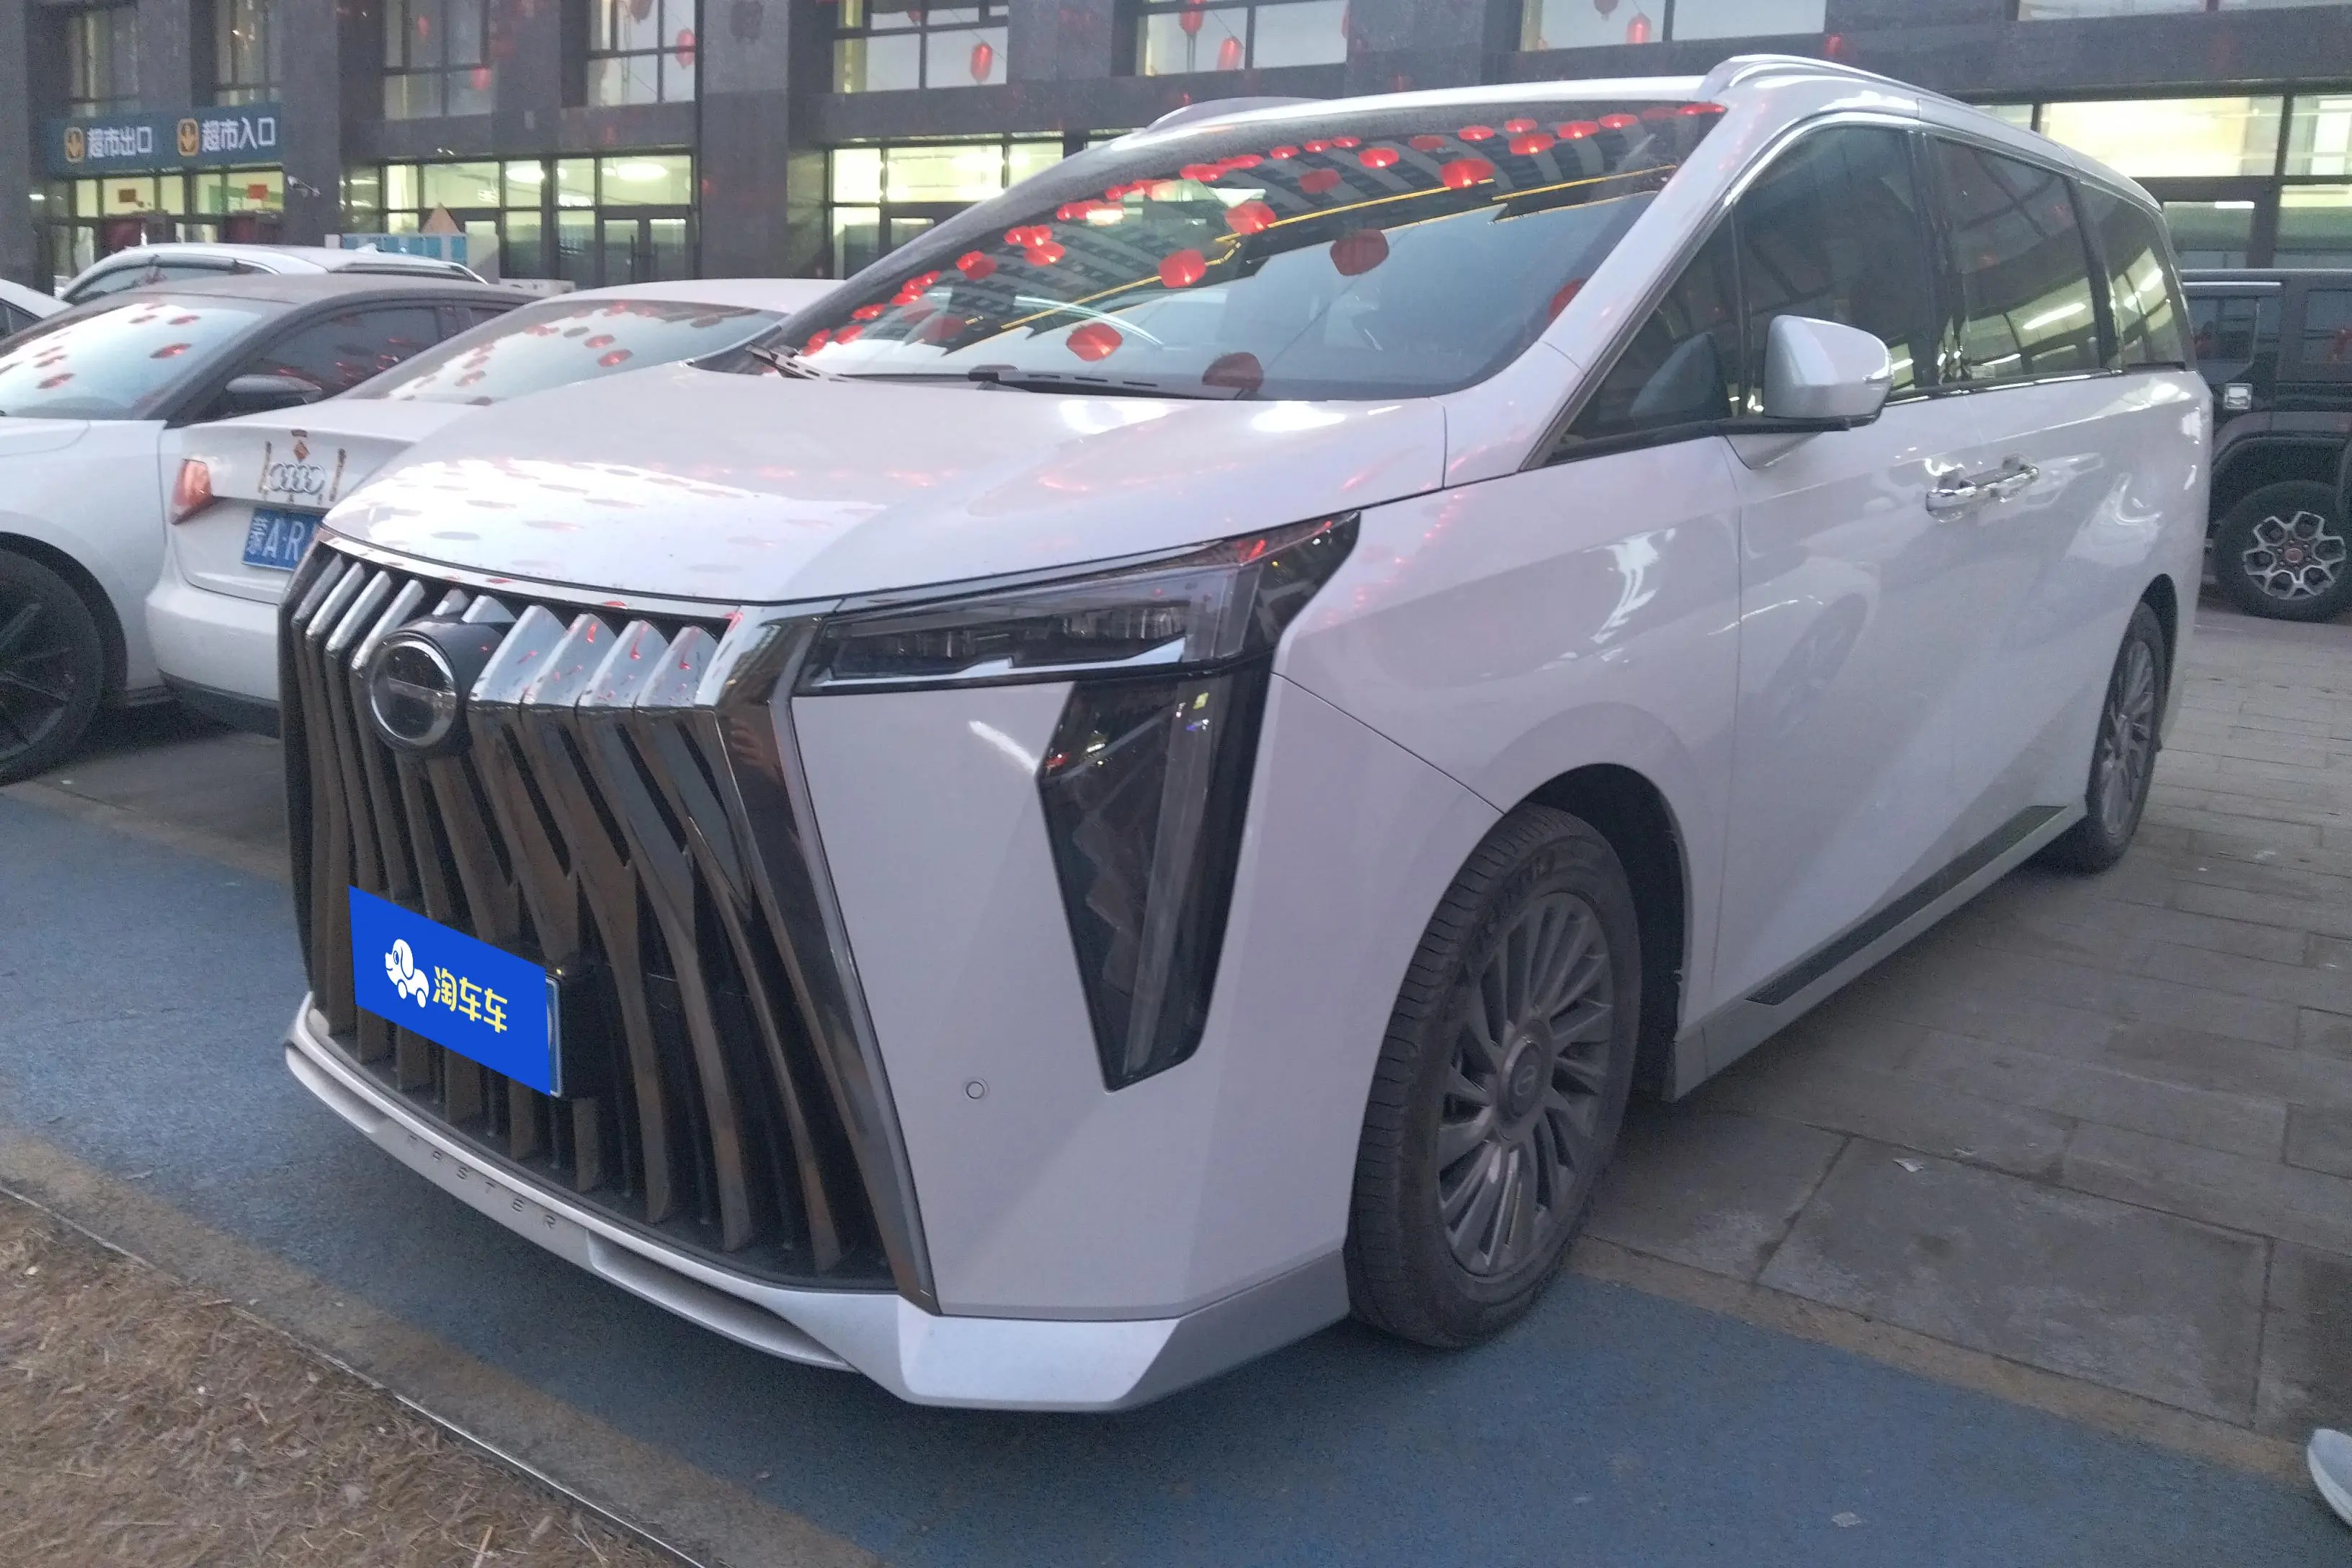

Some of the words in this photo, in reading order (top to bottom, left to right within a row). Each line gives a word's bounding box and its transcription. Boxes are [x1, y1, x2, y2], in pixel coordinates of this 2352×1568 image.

[88, 126, 153, 158] 超市出口
[202, 117, 277, 153] 超市入口
